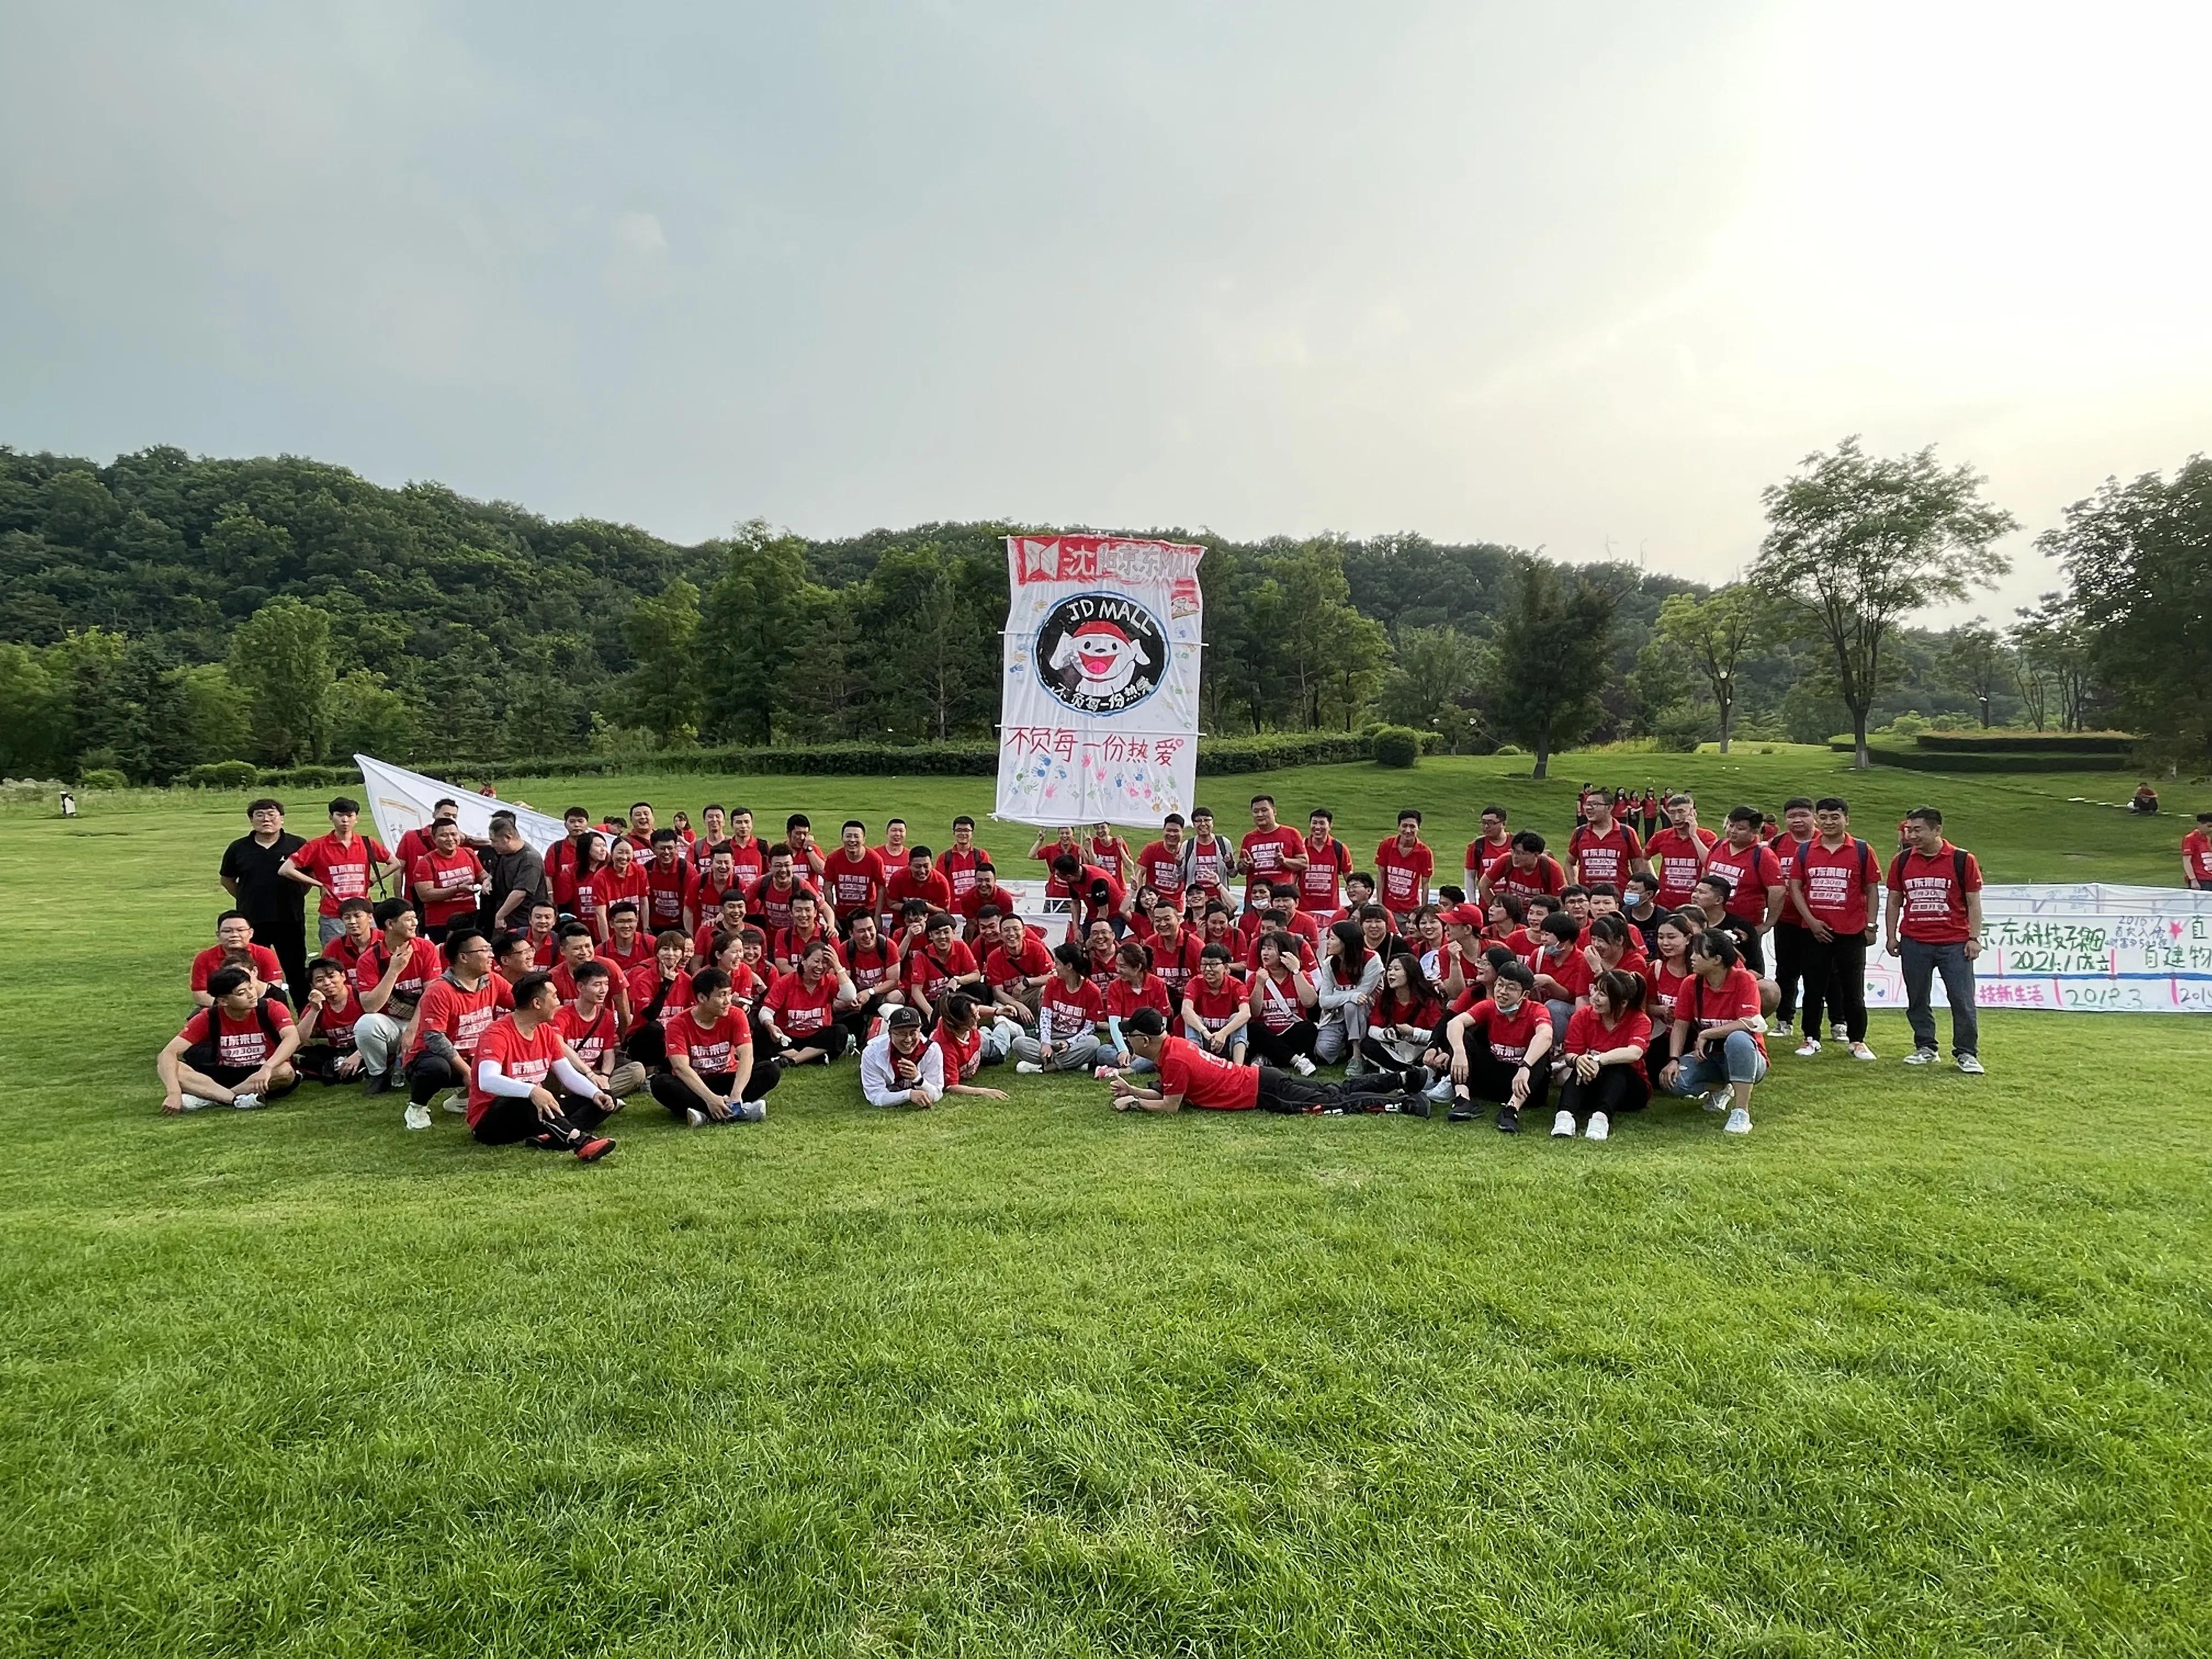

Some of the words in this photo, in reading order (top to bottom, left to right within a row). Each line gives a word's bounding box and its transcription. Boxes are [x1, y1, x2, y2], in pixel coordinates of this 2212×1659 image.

[1066, 599, 1094, 621] JD
[1098, 600, 1152, 636] MALL
[1004, 726, 1177, 766] 不负每一份热爱
